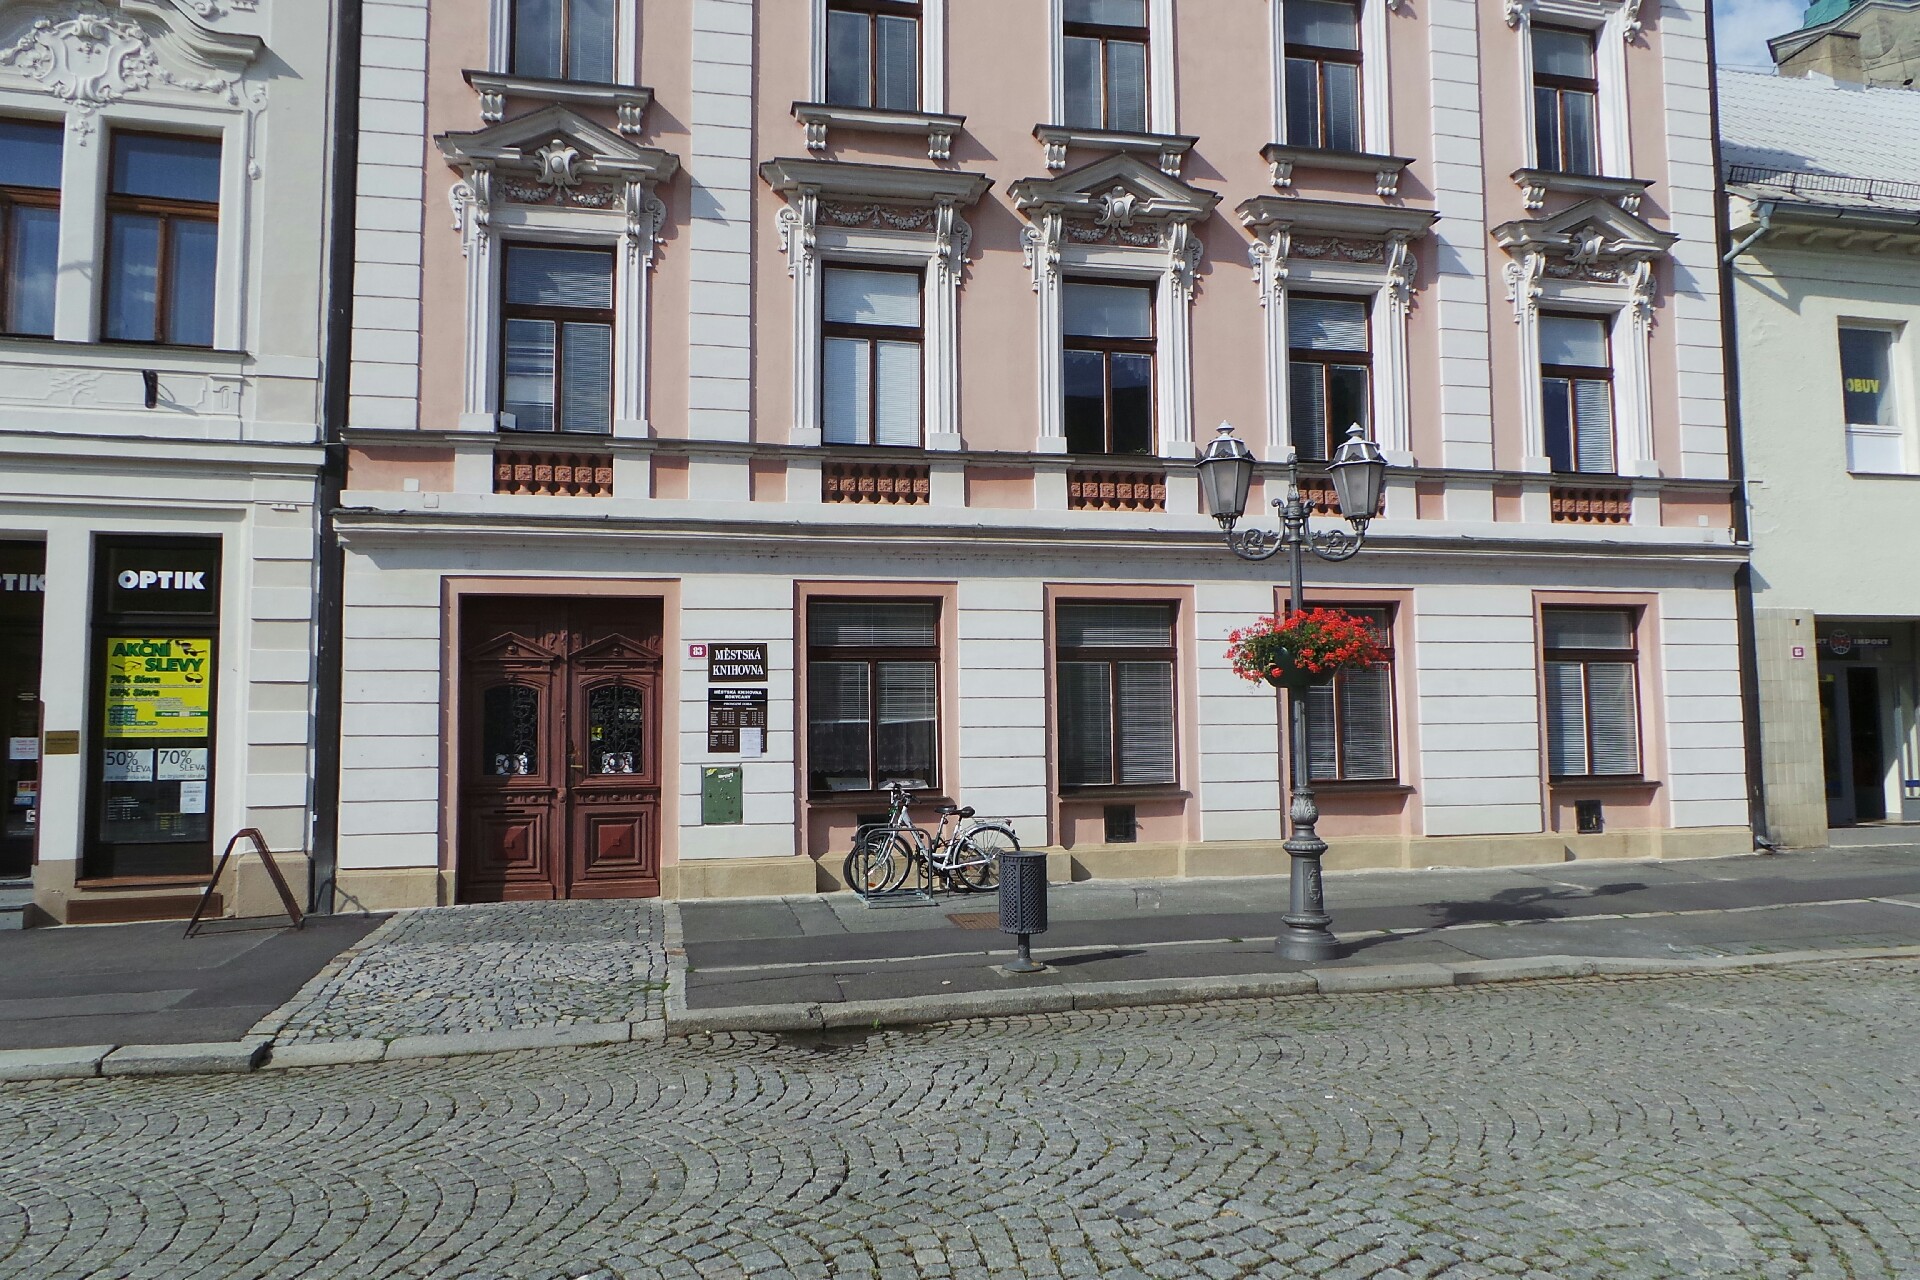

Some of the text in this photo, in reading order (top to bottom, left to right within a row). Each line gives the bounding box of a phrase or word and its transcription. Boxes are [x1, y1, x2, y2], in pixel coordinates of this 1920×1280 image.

[1846, 378, 1879, 393] OBUV
[0, 574, 46, 591] TIK
[118, 570, 205, 590] OPTIK
[112, 639, 173, 657] AKČNÍ
[692, 646, 703, 656] 83
[714, 647, 761, 660] MĚSTSKÁ
[145, 658, 204, 672] SLEVY
[712, 665, 764, 676] KNIHOVNA
[106, 751, 139, 766] 50%
[160, 750, 192, 765] 70%
[180, 764, 206, 772] SLEVA
